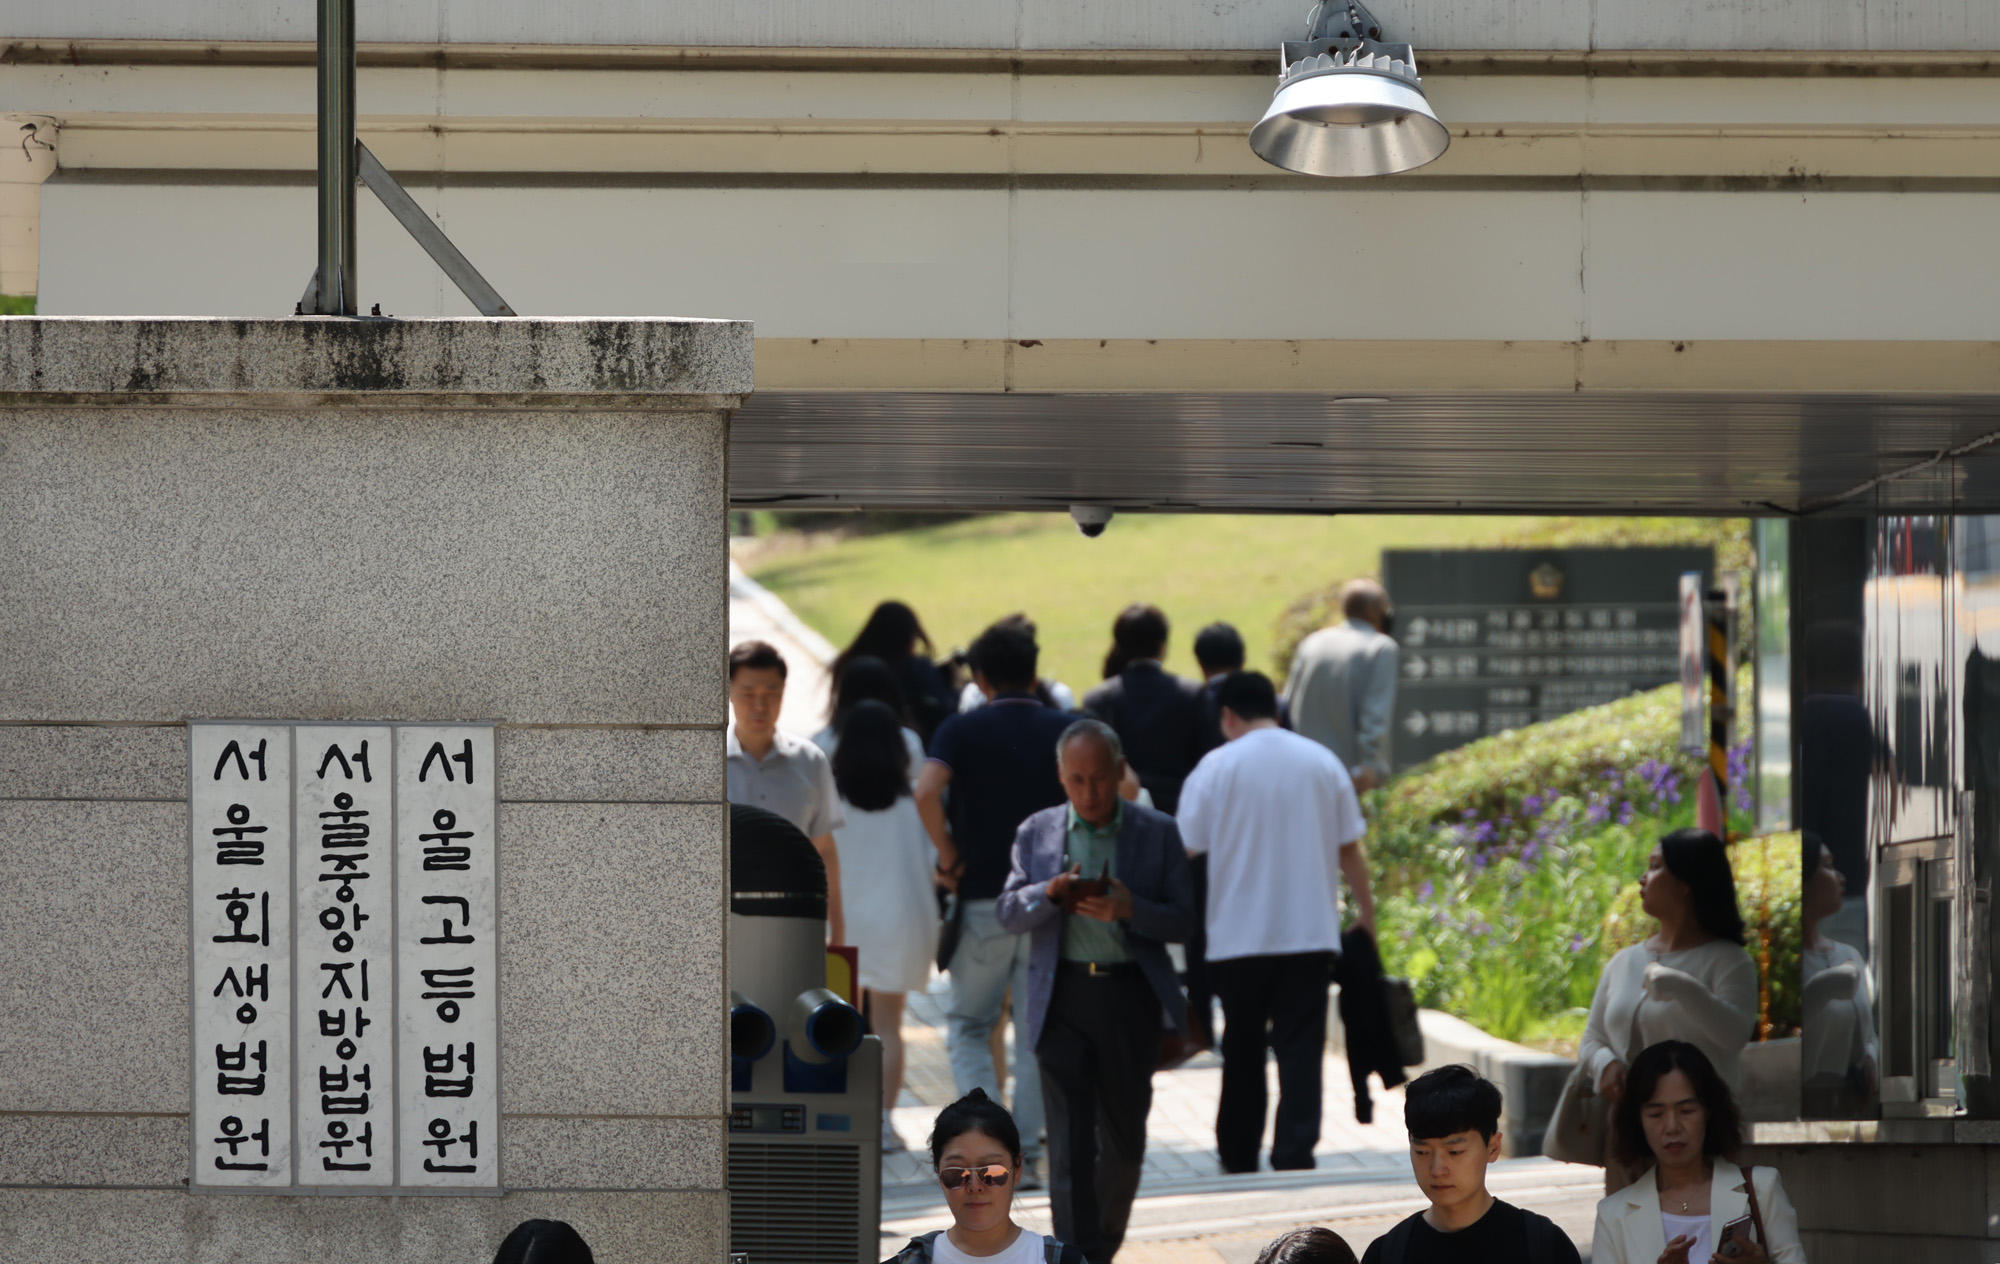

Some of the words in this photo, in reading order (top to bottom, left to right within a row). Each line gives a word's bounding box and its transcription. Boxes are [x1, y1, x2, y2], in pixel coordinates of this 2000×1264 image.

[212, 738, 270, 1172] 서울회생법원
[316, 739, 373, 1172] 서울중앙지방법원
[418, 738, 478, 1174] 서울고등법원
